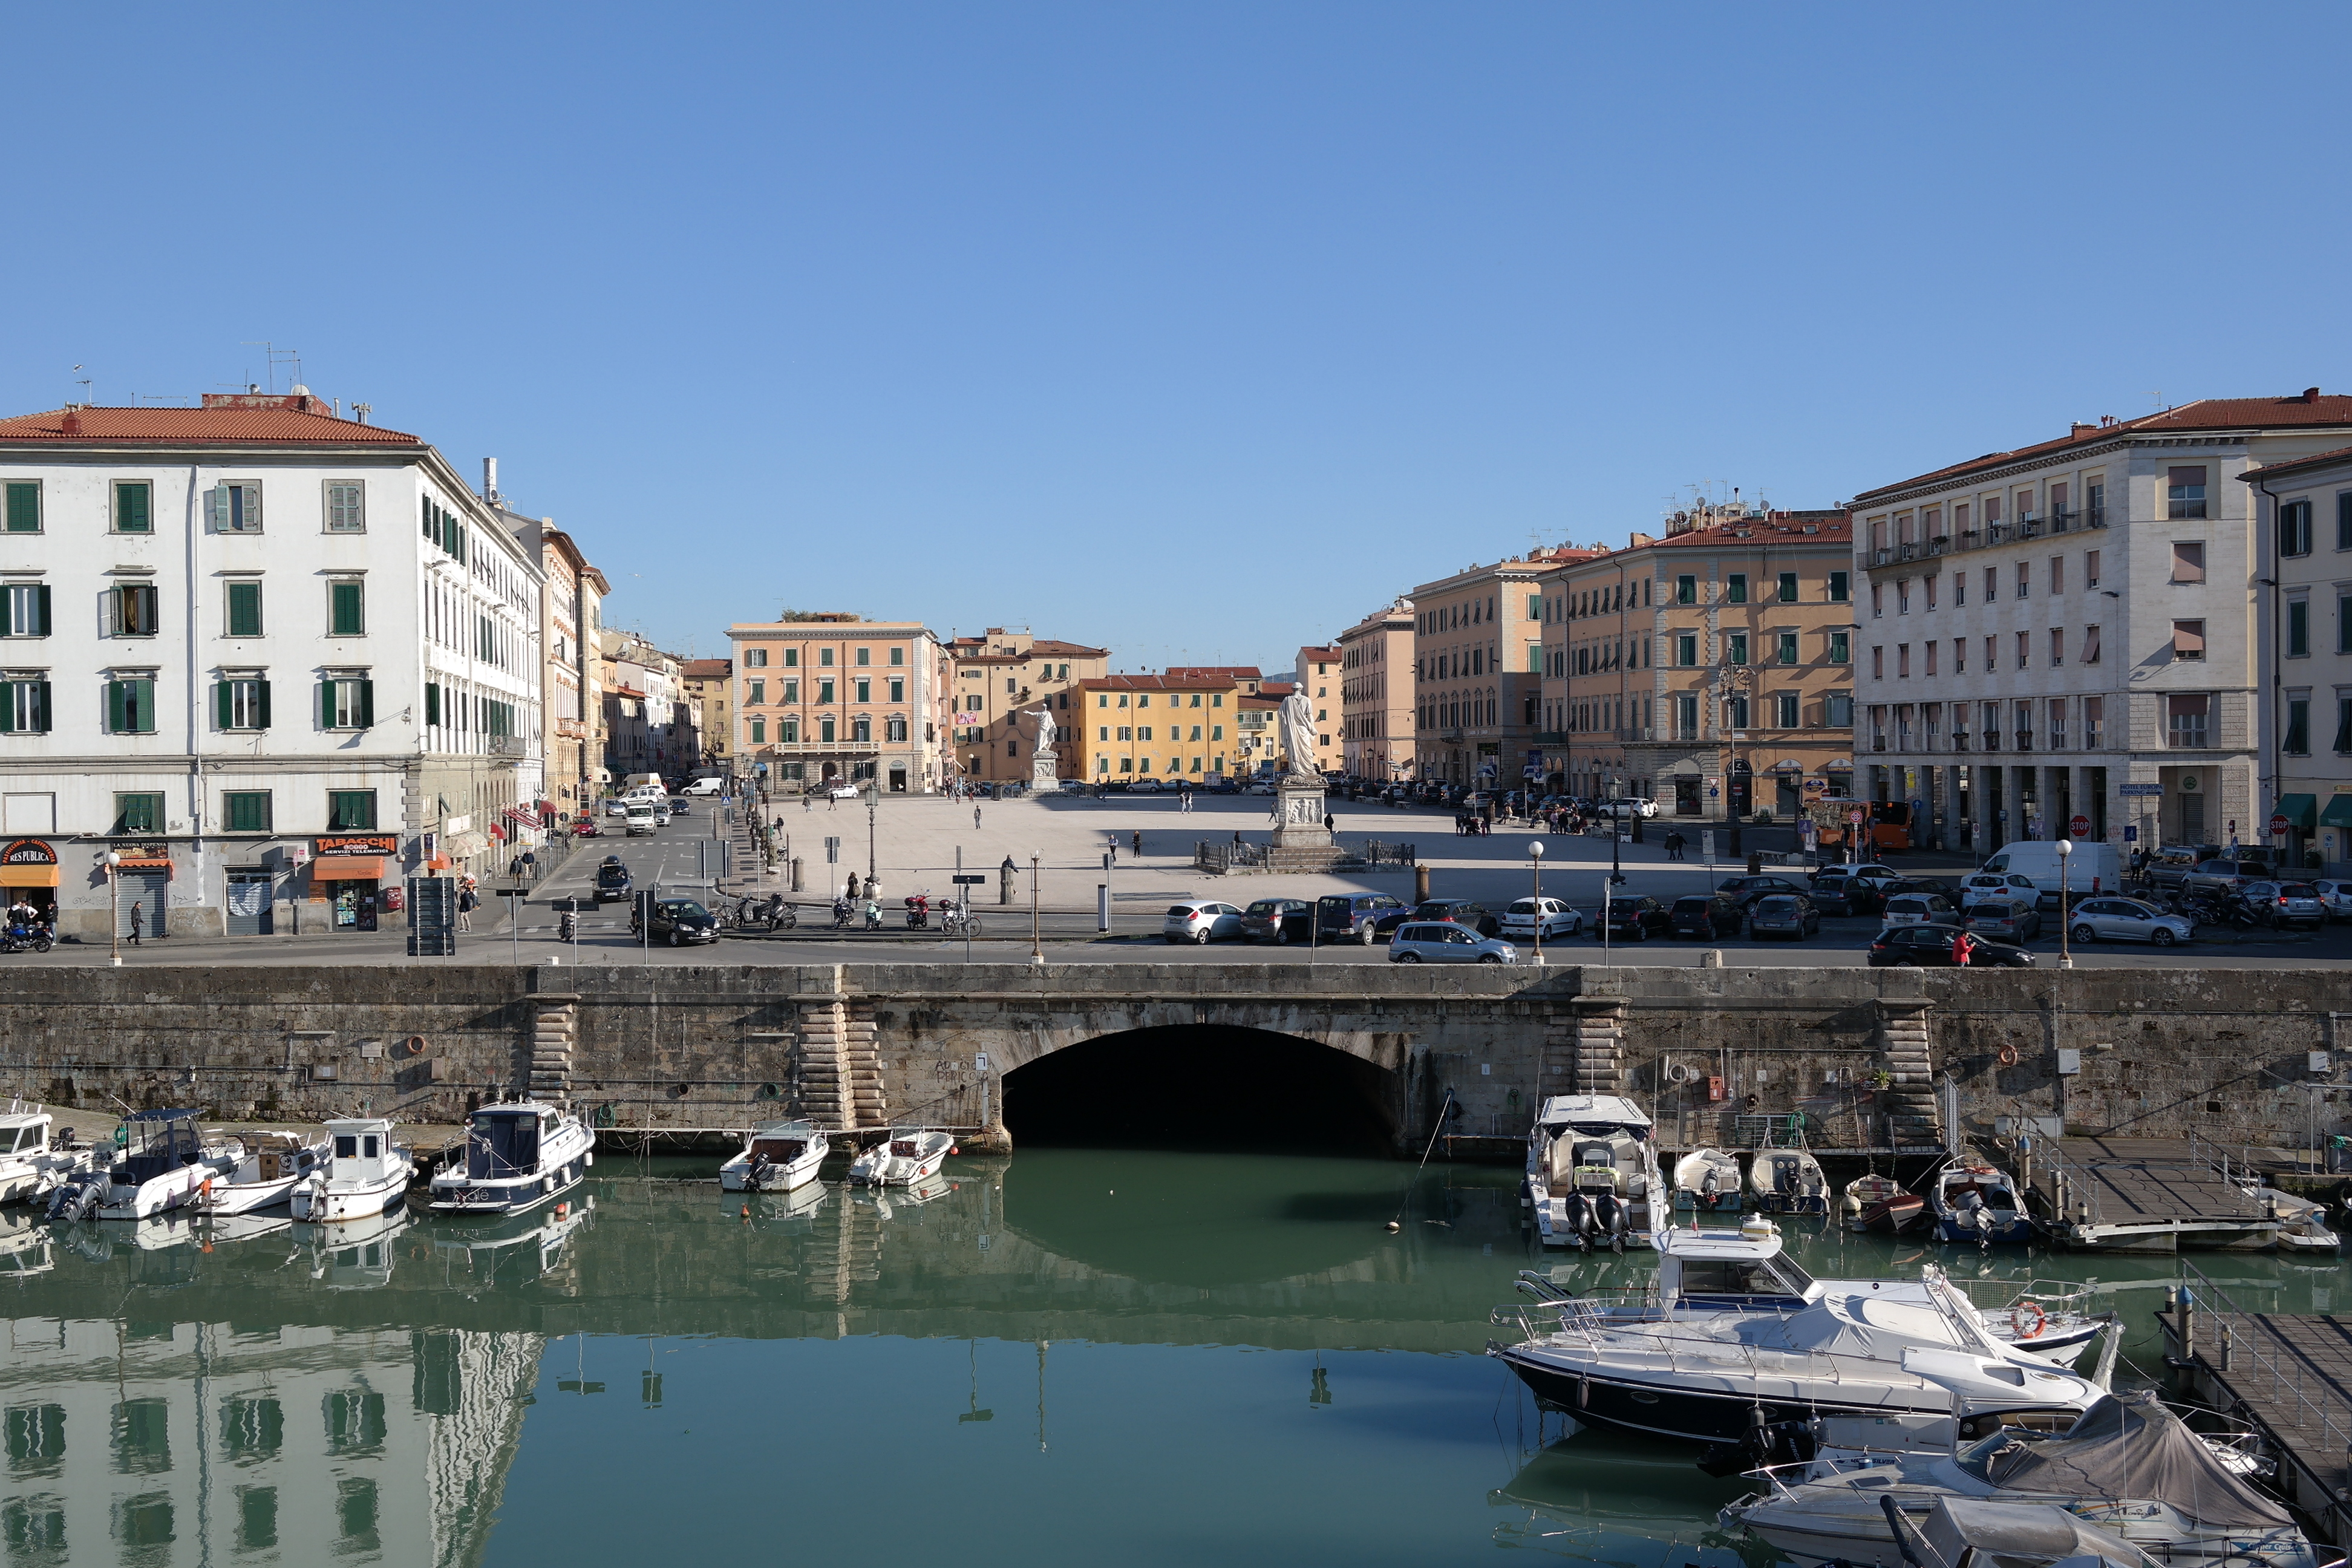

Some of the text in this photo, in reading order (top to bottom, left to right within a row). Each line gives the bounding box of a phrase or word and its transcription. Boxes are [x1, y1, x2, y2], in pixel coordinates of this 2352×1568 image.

[2071, 822, 2089, 831] STOP
[2, 838, 56, 864] PASTICCERIA CAFFETTERIA
[316, 837, 395, 852] TABACCHI
[10, 850, 50, 861] RES PUBLICA
[935, 1060, 976, 1071] ADGIO
[1759, 1428, 1769, 1449] MERCURY
